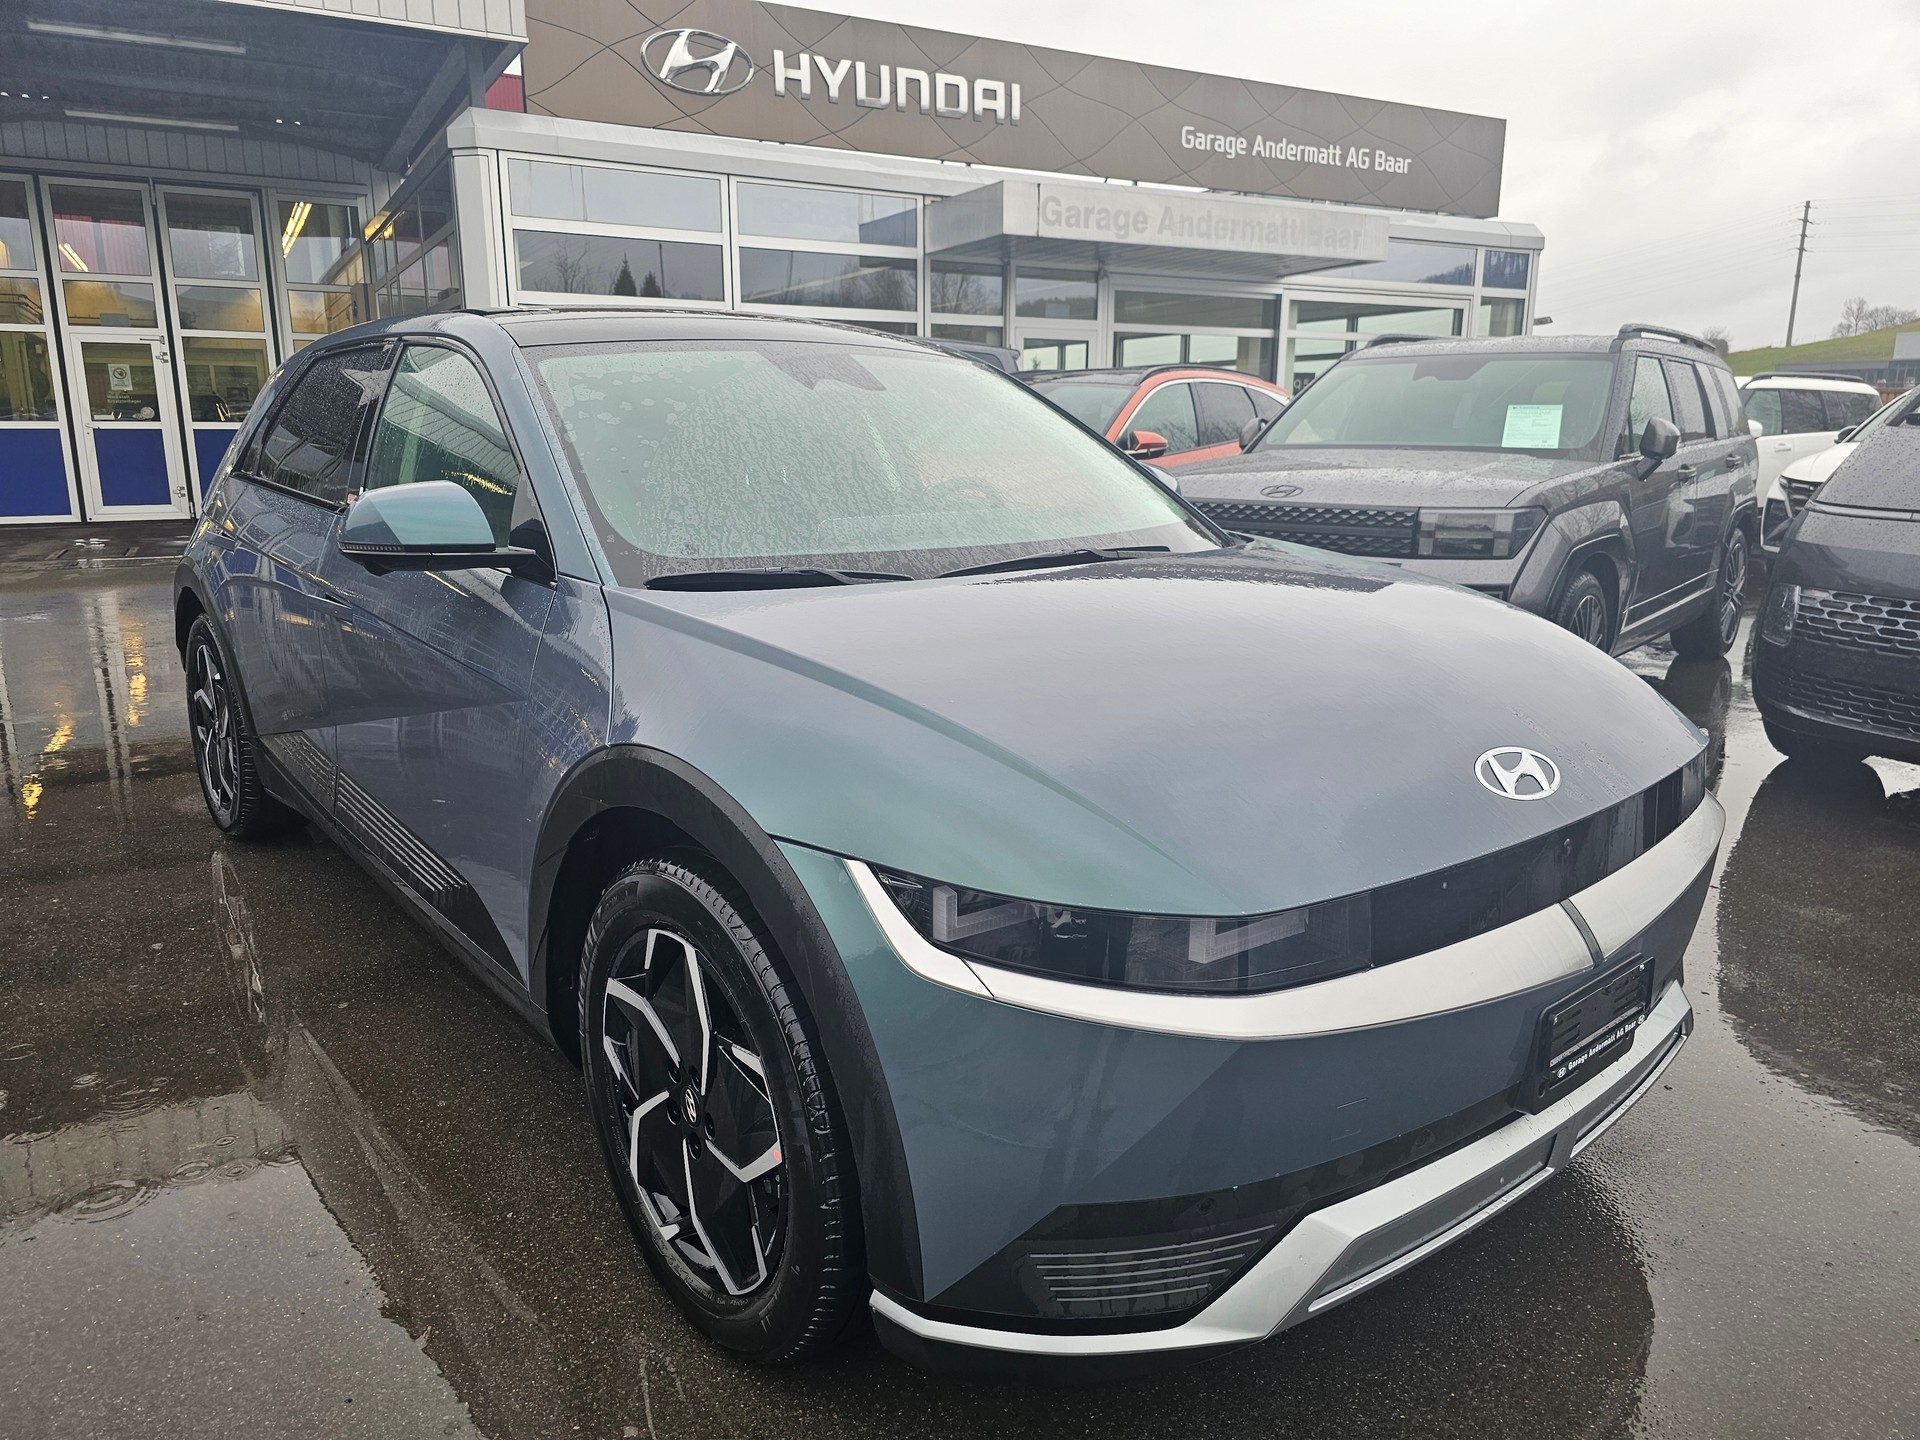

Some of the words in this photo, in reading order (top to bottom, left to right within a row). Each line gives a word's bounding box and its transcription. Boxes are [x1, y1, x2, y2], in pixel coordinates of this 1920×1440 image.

[773, 49, 1020, 126] HYUNDAI
[1182, 126, 1247, 159] Garage
[1252, 135, 1342, 166] Andermatt
[1346, 147, 1370, 170] AG
[1375, 150, 1412, 174] Baar
[1040, 195, 1149, 239] Garage
[1157, 206, 1298, 246] Andermatt
[1568, 1053, 1588, 1070] Garage
[1616, 1028, 1624, 1039] AG
[1625, 1021, 1637, 1033] Baar
